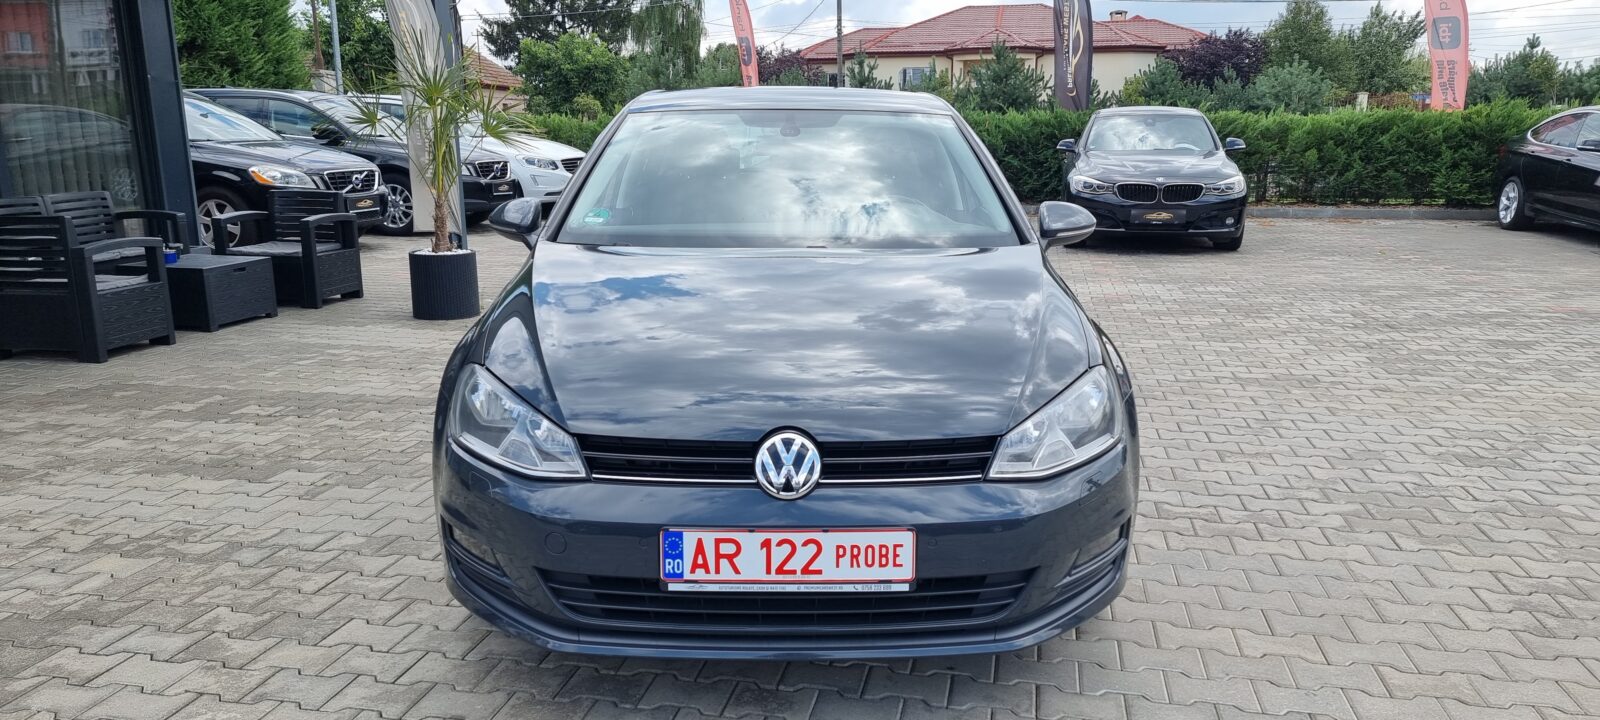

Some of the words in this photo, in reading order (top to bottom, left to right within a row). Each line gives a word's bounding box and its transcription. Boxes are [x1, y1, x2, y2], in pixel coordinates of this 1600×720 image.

[665, 559, 683, 574] RO
[689, 537, 742, 575] AR
[760, 538, 823, 575] 122
[835, 543, 904, 568] PROBE
